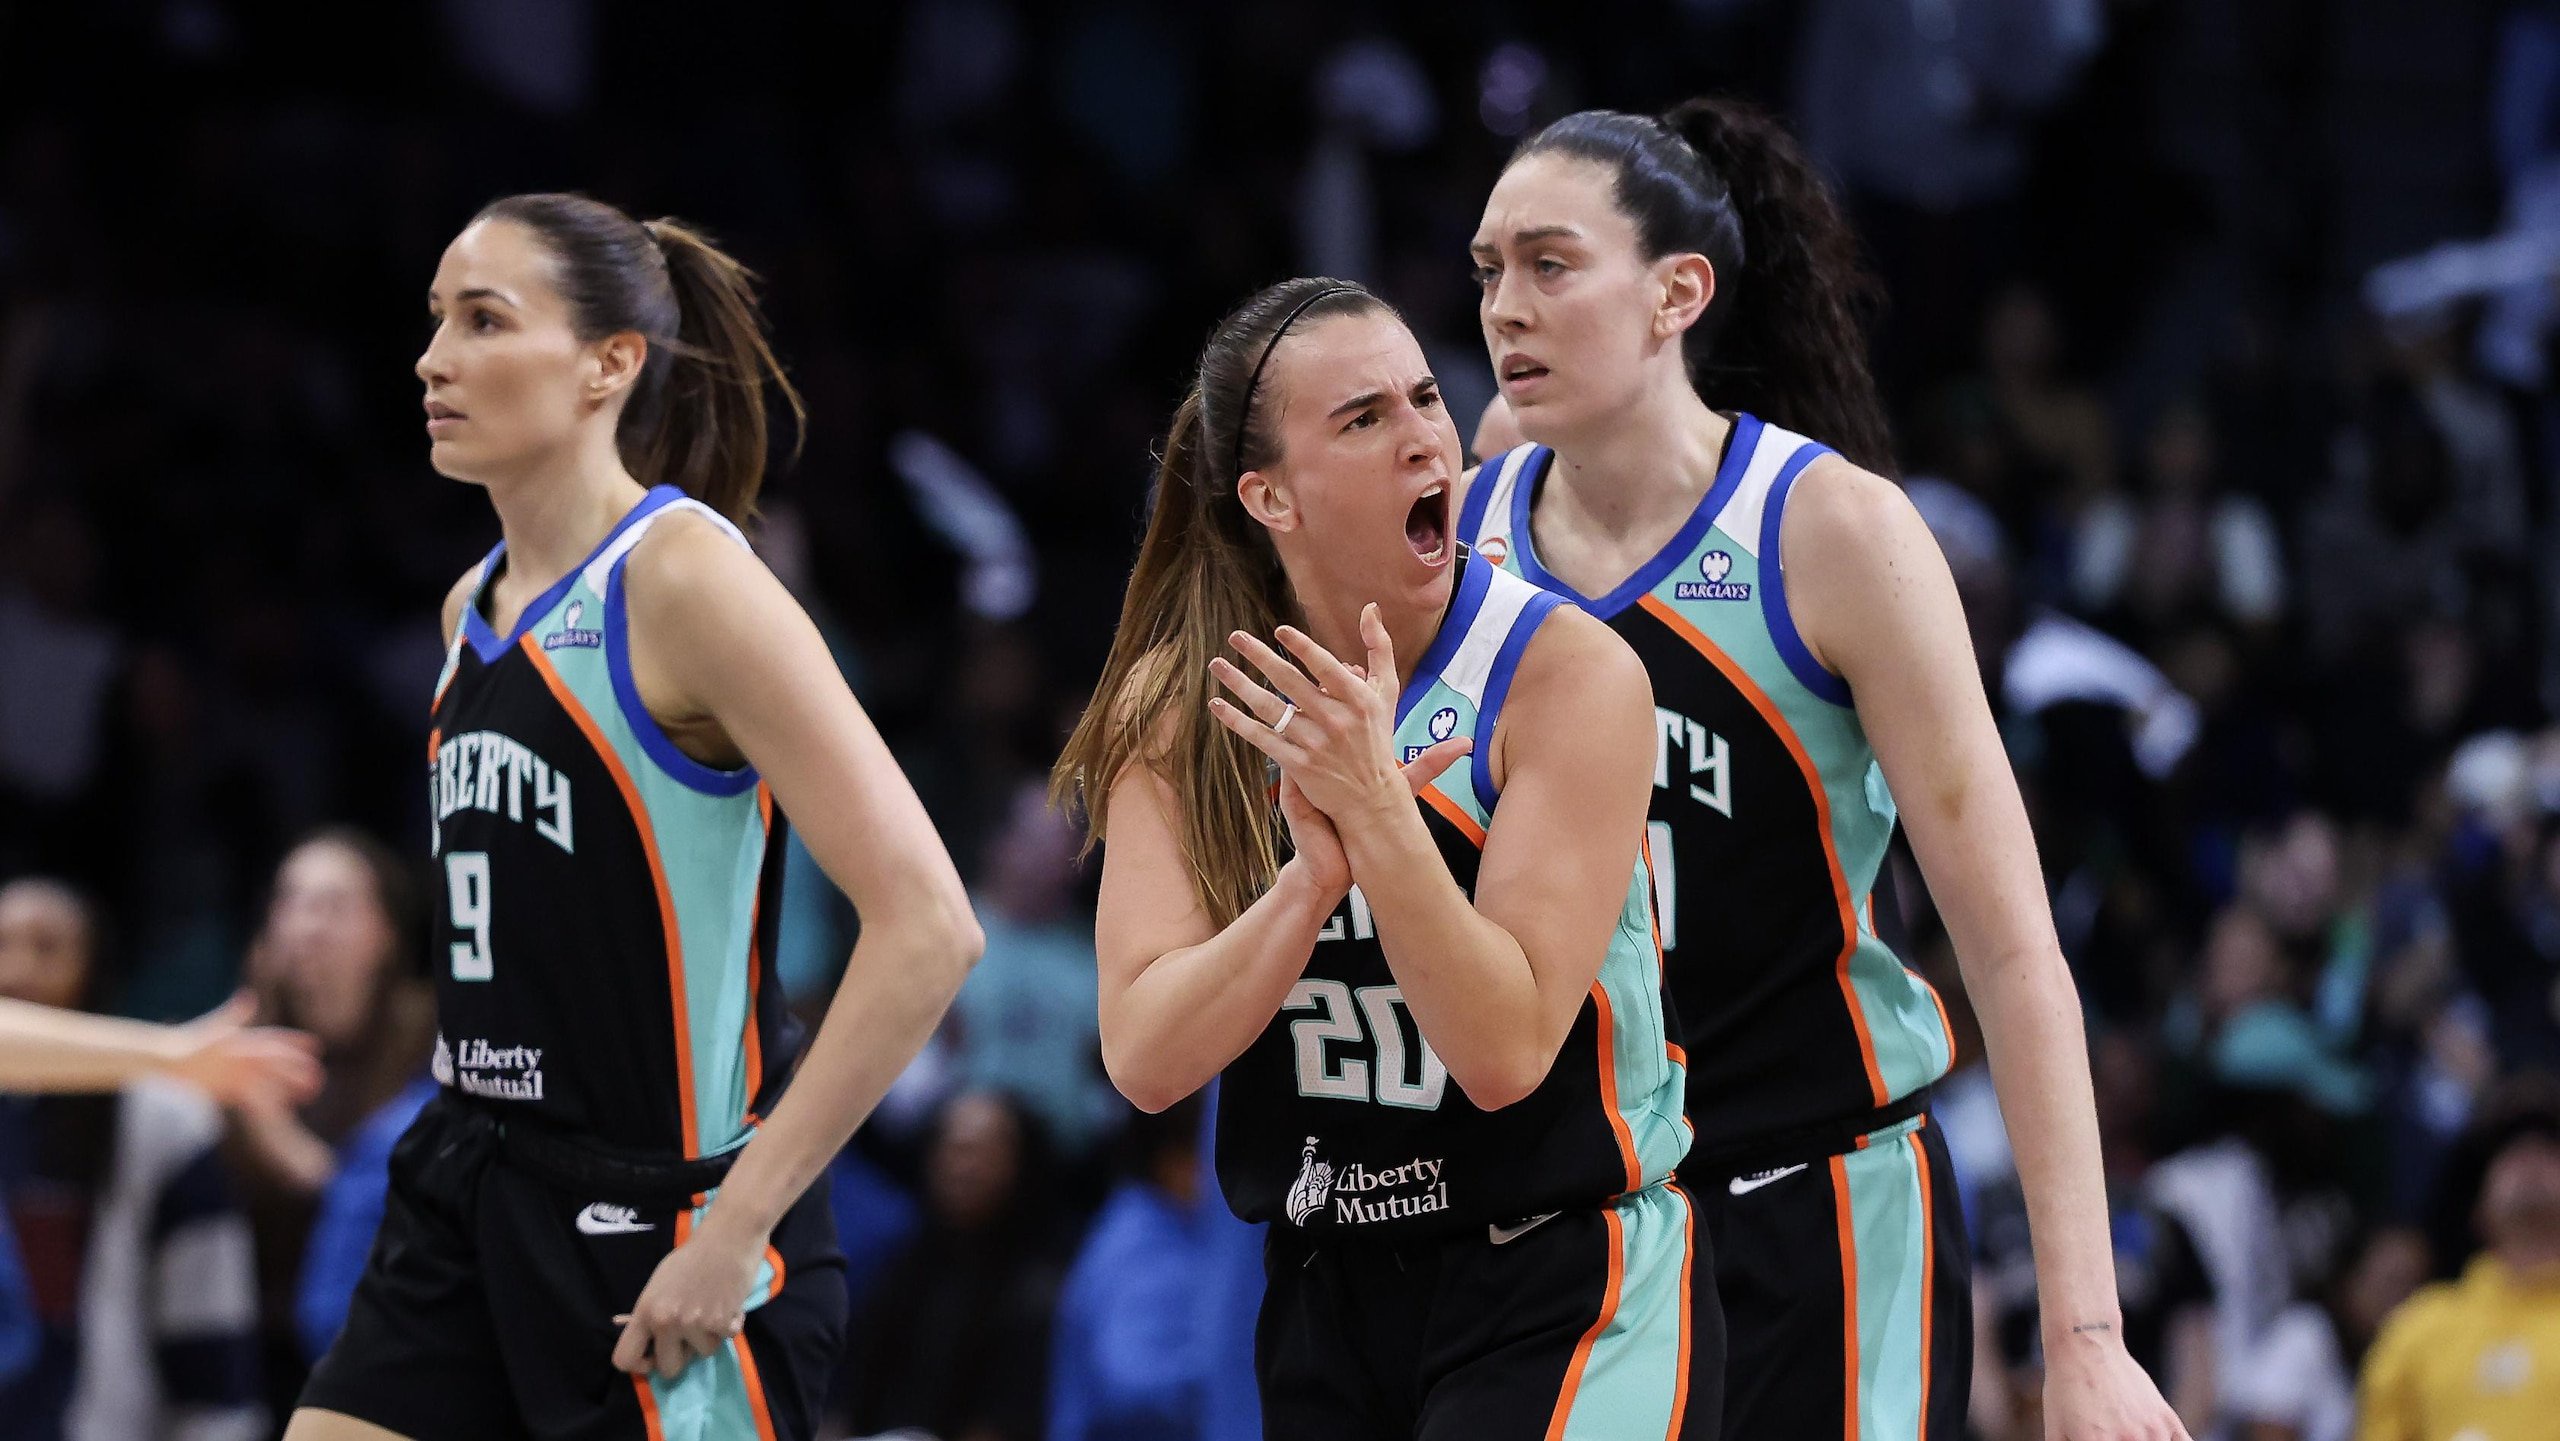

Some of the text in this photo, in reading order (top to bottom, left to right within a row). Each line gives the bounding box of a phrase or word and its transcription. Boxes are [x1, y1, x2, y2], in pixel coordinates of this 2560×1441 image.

[1677, 583, 1749, 599] BARCLAYS
[430, 729, 574, 859] BERTY
[445, 851, 494, 982] 9
[459, 1038, 542, 1080] Liberty
[1282, 978, 1447, 1111] 20
[460, 1070, 543, 1100] Mutual
[1335, 1157, 1443, 1191] Liberty
[1335, 1181, 1450, 1224] Mutual
